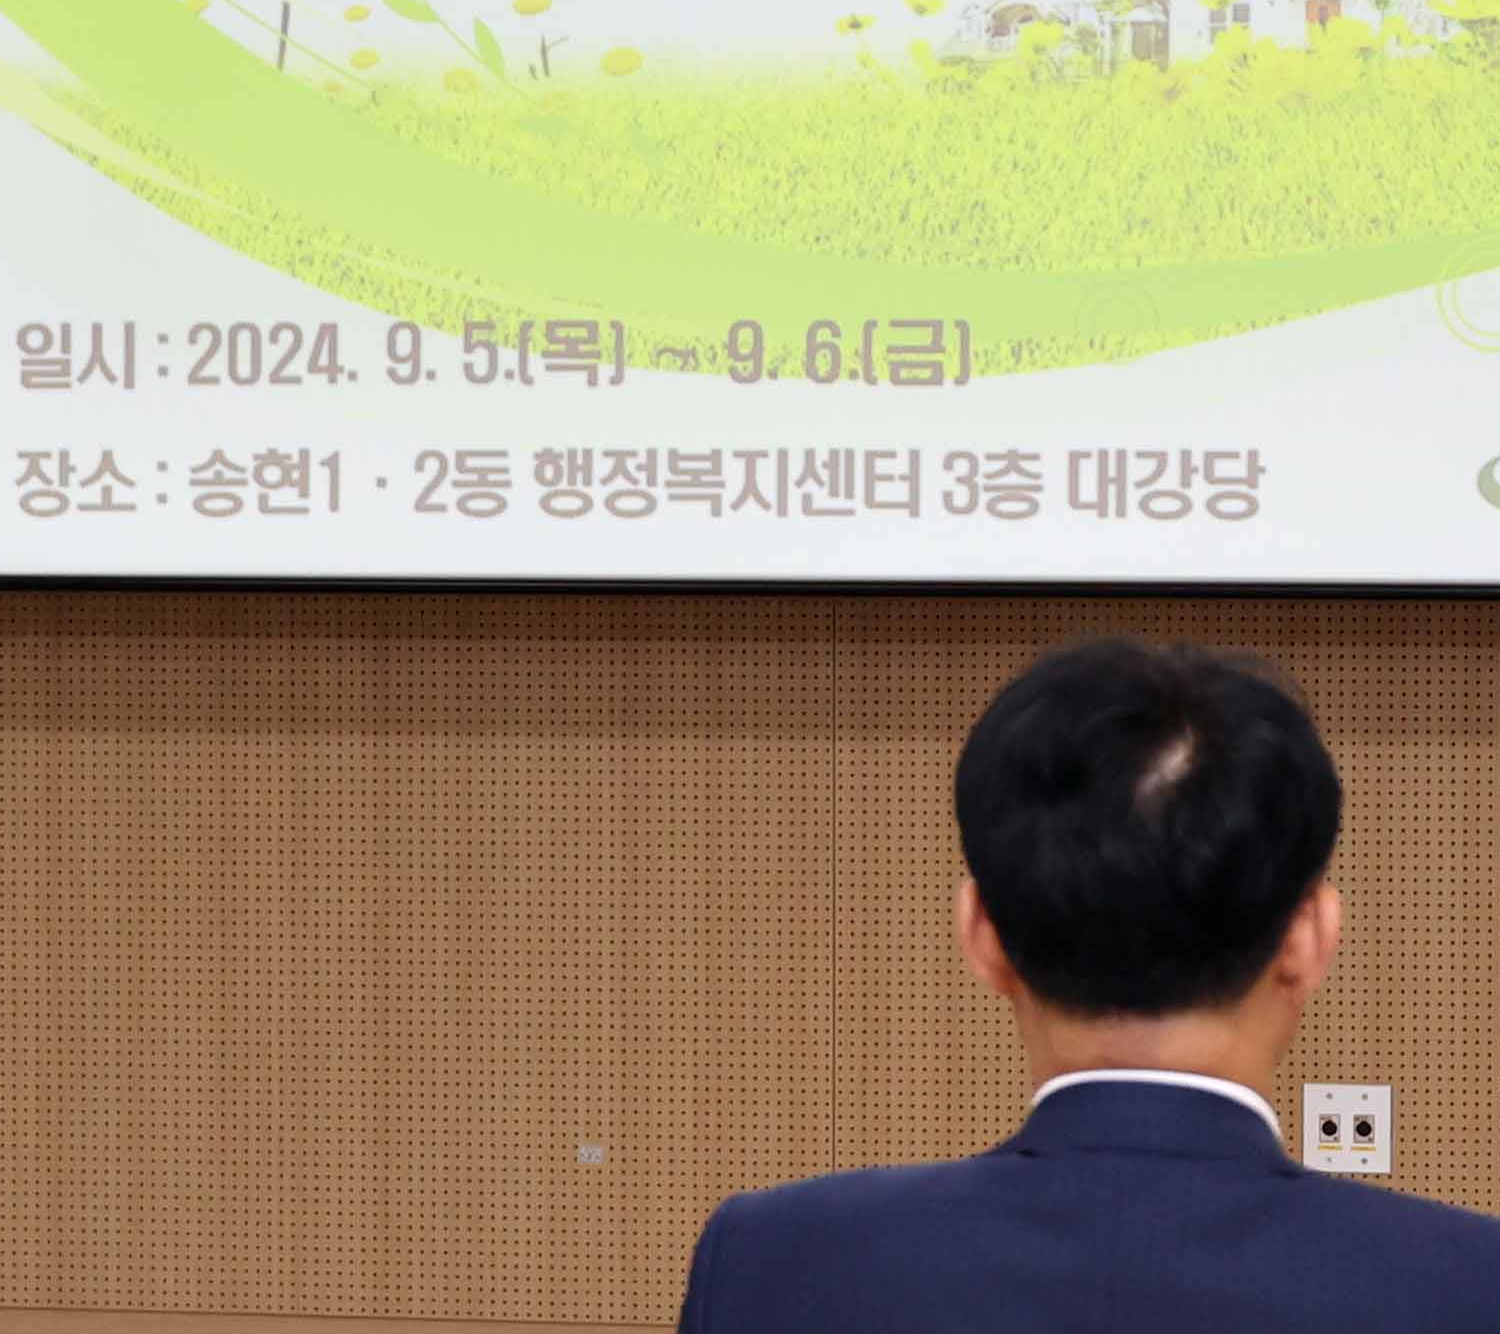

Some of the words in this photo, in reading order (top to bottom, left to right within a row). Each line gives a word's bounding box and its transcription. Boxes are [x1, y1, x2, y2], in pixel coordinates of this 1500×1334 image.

[385, 320, 437, 387] 9.
[461, 319, 626, 389] 5.(목)
[726, 319, 778, 386] 9.
[803, 319, 972, 388] 6.(금)
[189, 448, 341, 519] 송현1
[413, 448, 513, 519] 2동
[532, 447, 921, 520] 행정복지센터
[941, 448, 1045, 521] 3층
[1066, 448, 1265, 522] 대강당
